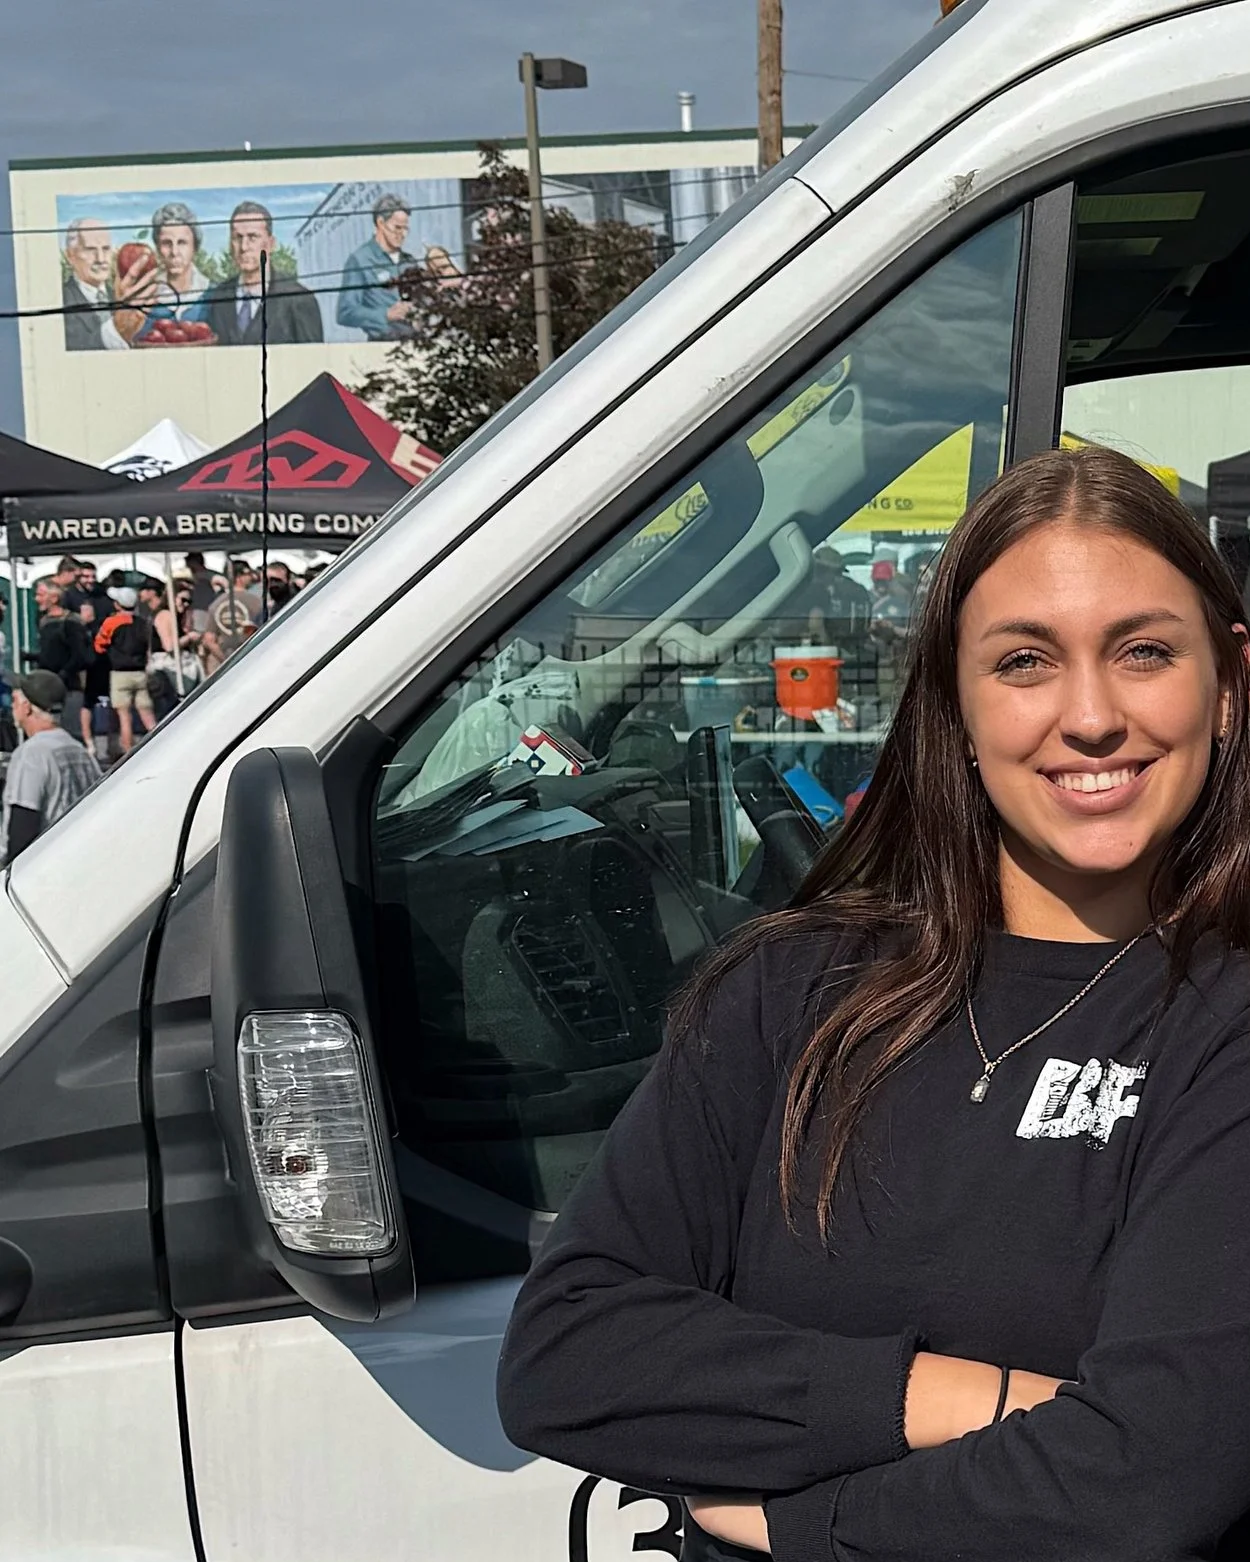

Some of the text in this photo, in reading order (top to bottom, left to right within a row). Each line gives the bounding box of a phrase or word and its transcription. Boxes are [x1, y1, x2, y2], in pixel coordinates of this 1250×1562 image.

[867, 497, 891, 510] NG
[21, 512, 381, 540] WAREDACA BREWING COM
